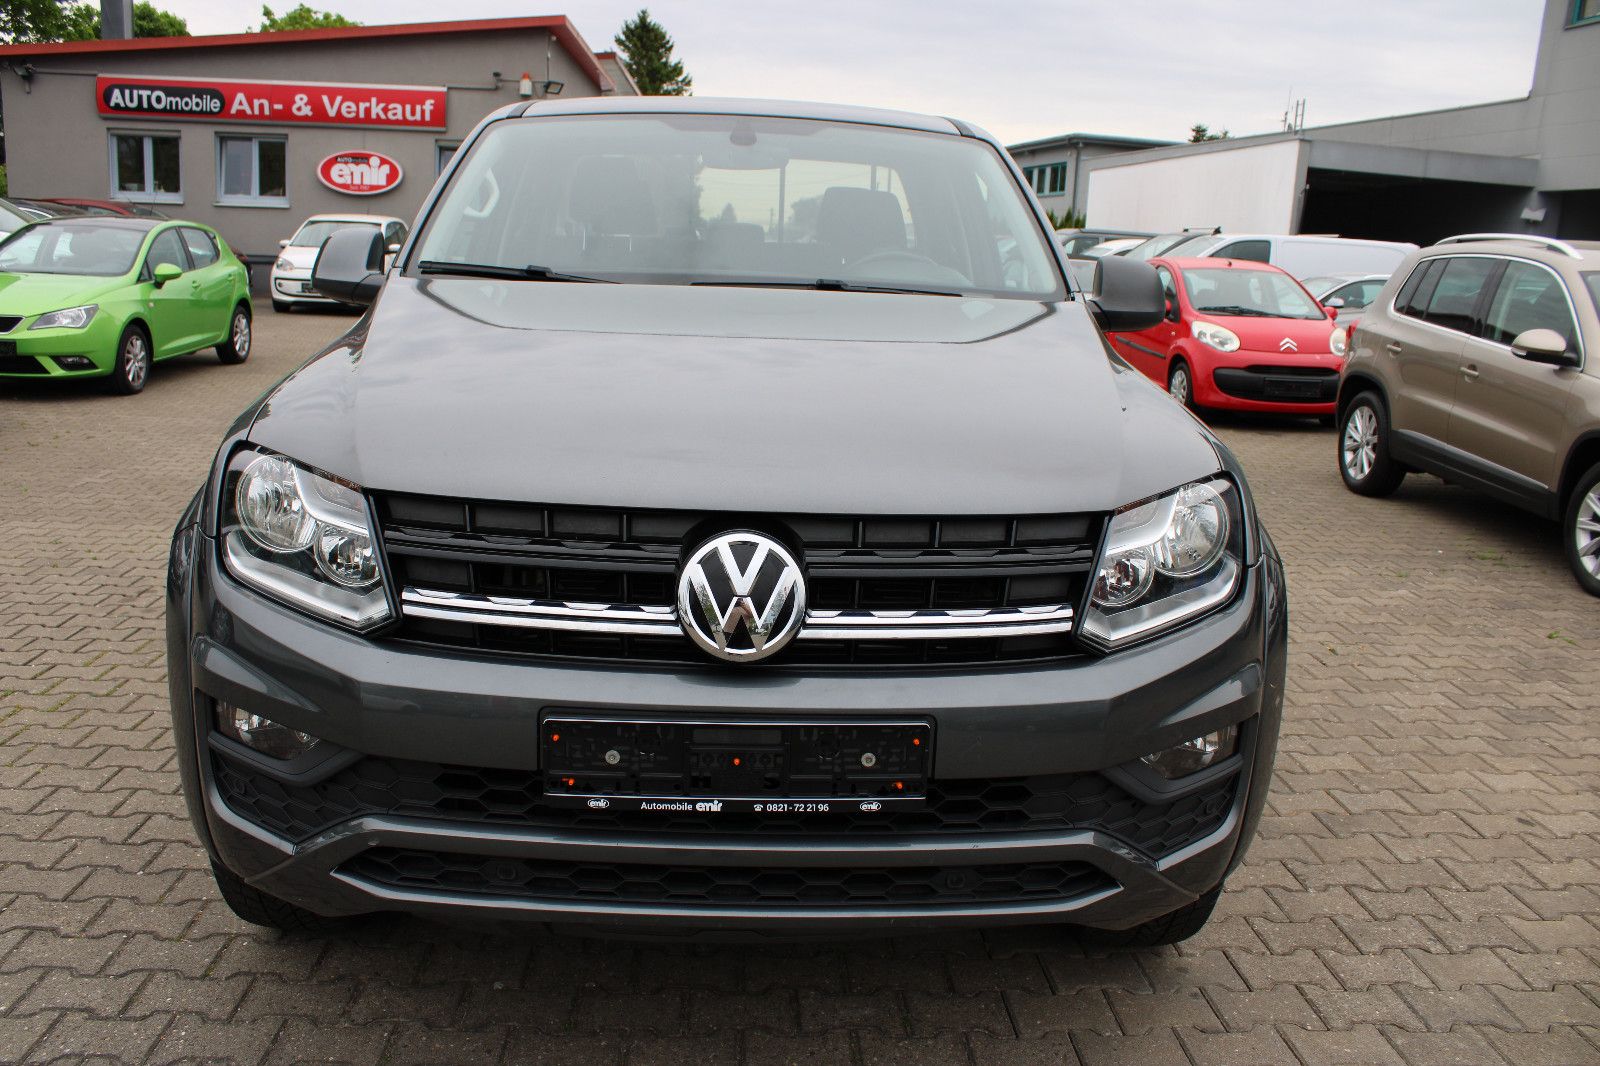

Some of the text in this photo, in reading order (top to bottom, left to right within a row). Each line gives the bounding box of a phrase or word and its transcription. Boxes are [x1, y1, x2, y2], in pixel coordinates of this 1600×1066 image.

[109, 88, 435, 122] AUTOmobile An- & Verkauf
[330, 156, 390, 186] emir
[640, 800, 723, 812] Automobile emir
